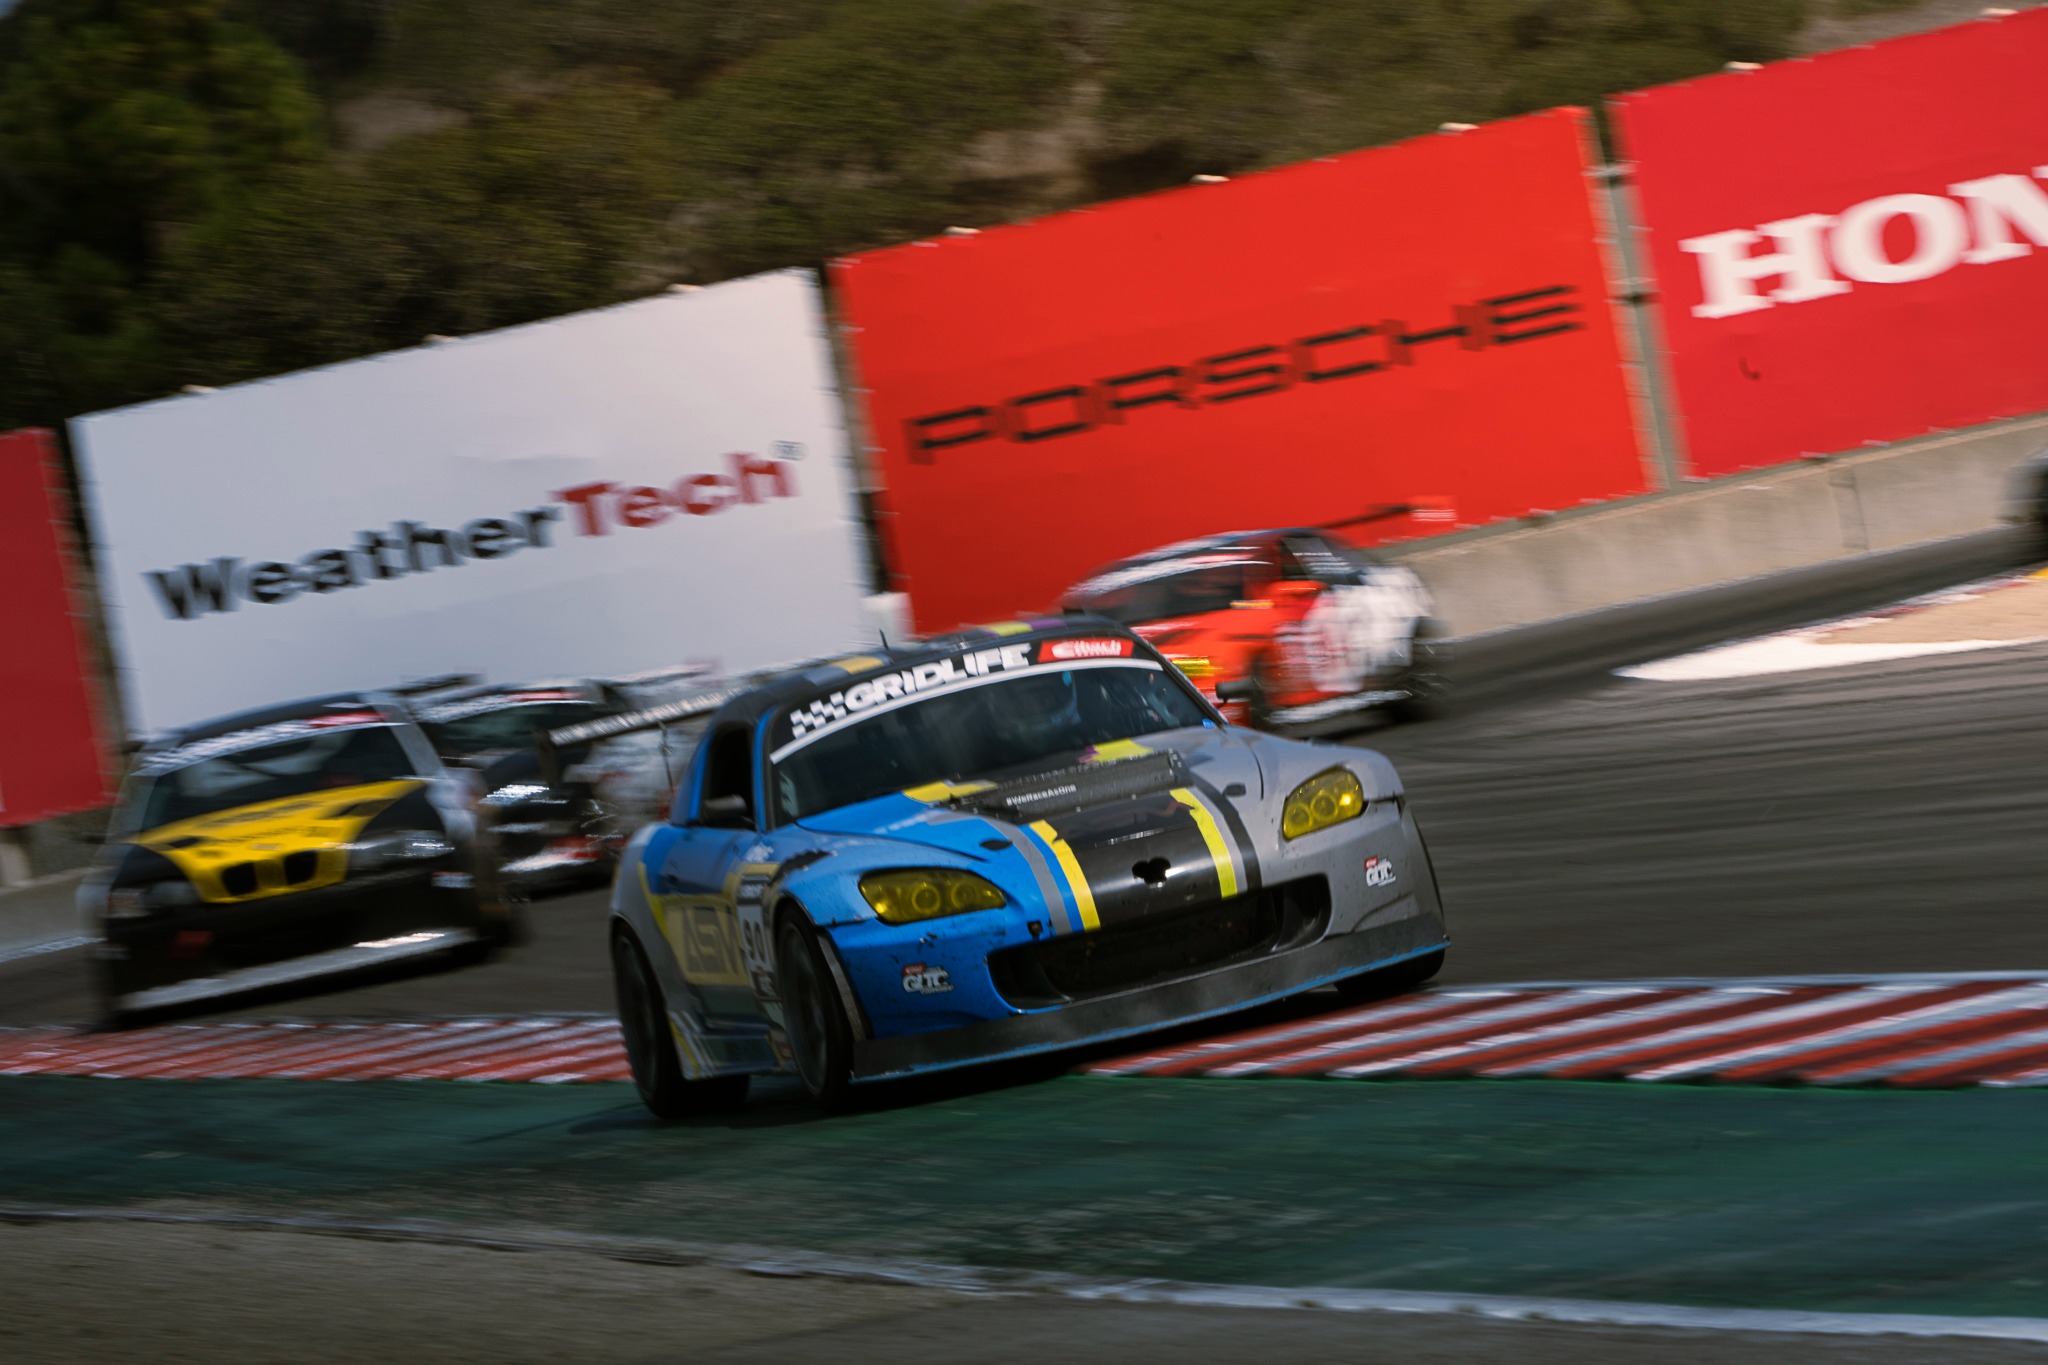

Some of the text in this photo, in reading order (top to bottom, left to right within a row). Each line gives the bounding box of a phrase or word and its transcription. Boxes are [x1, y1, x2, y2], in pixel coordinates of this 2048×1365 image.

[906, 283, 1586, 465] PORSCHE
[141, 450, 799, 621] WeatherTech
[845, 642, 1032, 712] GRIDLIFE
